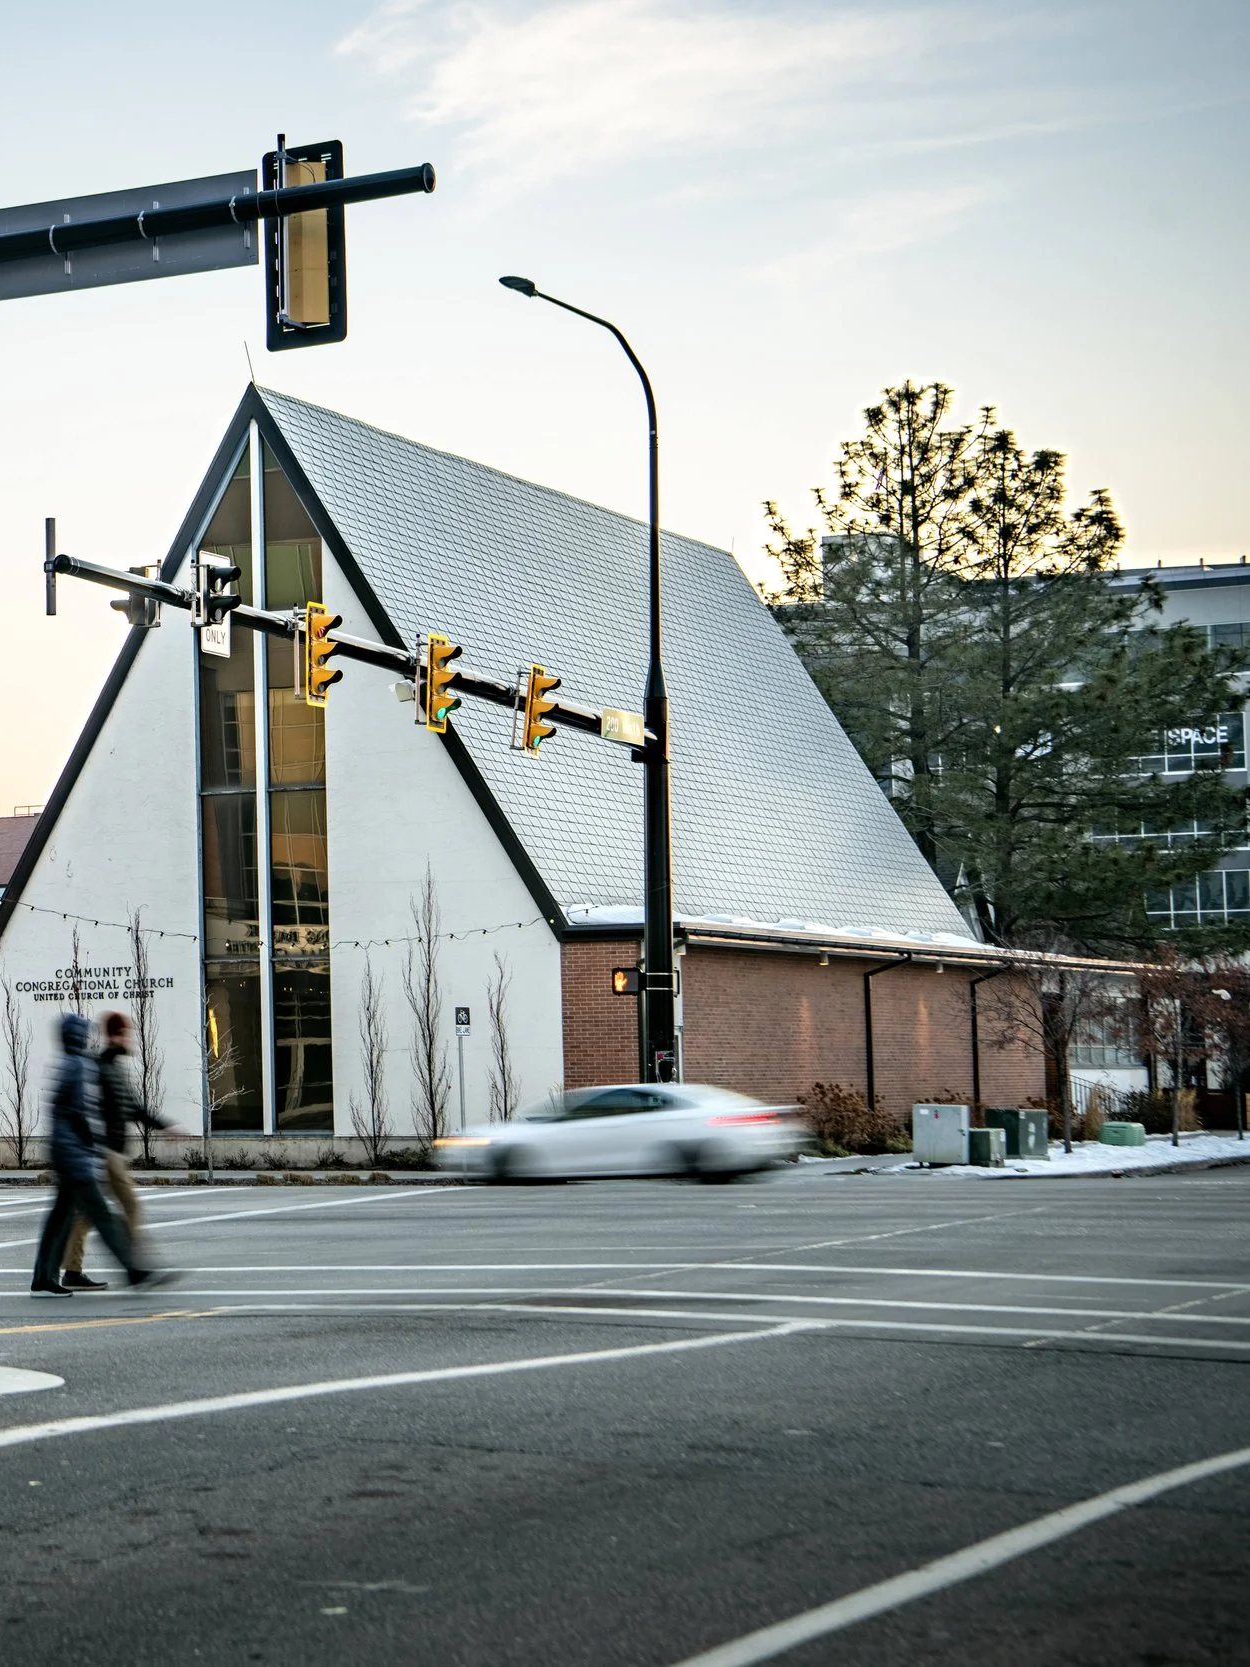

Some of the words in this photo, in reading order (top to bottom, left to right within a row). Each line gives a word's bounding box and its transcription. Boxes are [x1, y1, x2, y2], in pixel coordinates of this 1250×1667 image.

[206, 628, 226, 645] ONLY
[606, 716, 619, 732] 200
[1168, 726, 1228, 746] SPACE
[55, 967, 132, 978] COMMUNITY
[15, 979, 119, 991] CONGREGATIONAL
[124, 978, 174, 989] CHURCH
[34, 993, 65, 1001] UNITED
[68, 992, 104, 1000] CHURCH
[108, 991, 119, 999] OF
[123, 991, 155, 999] CHRIST
